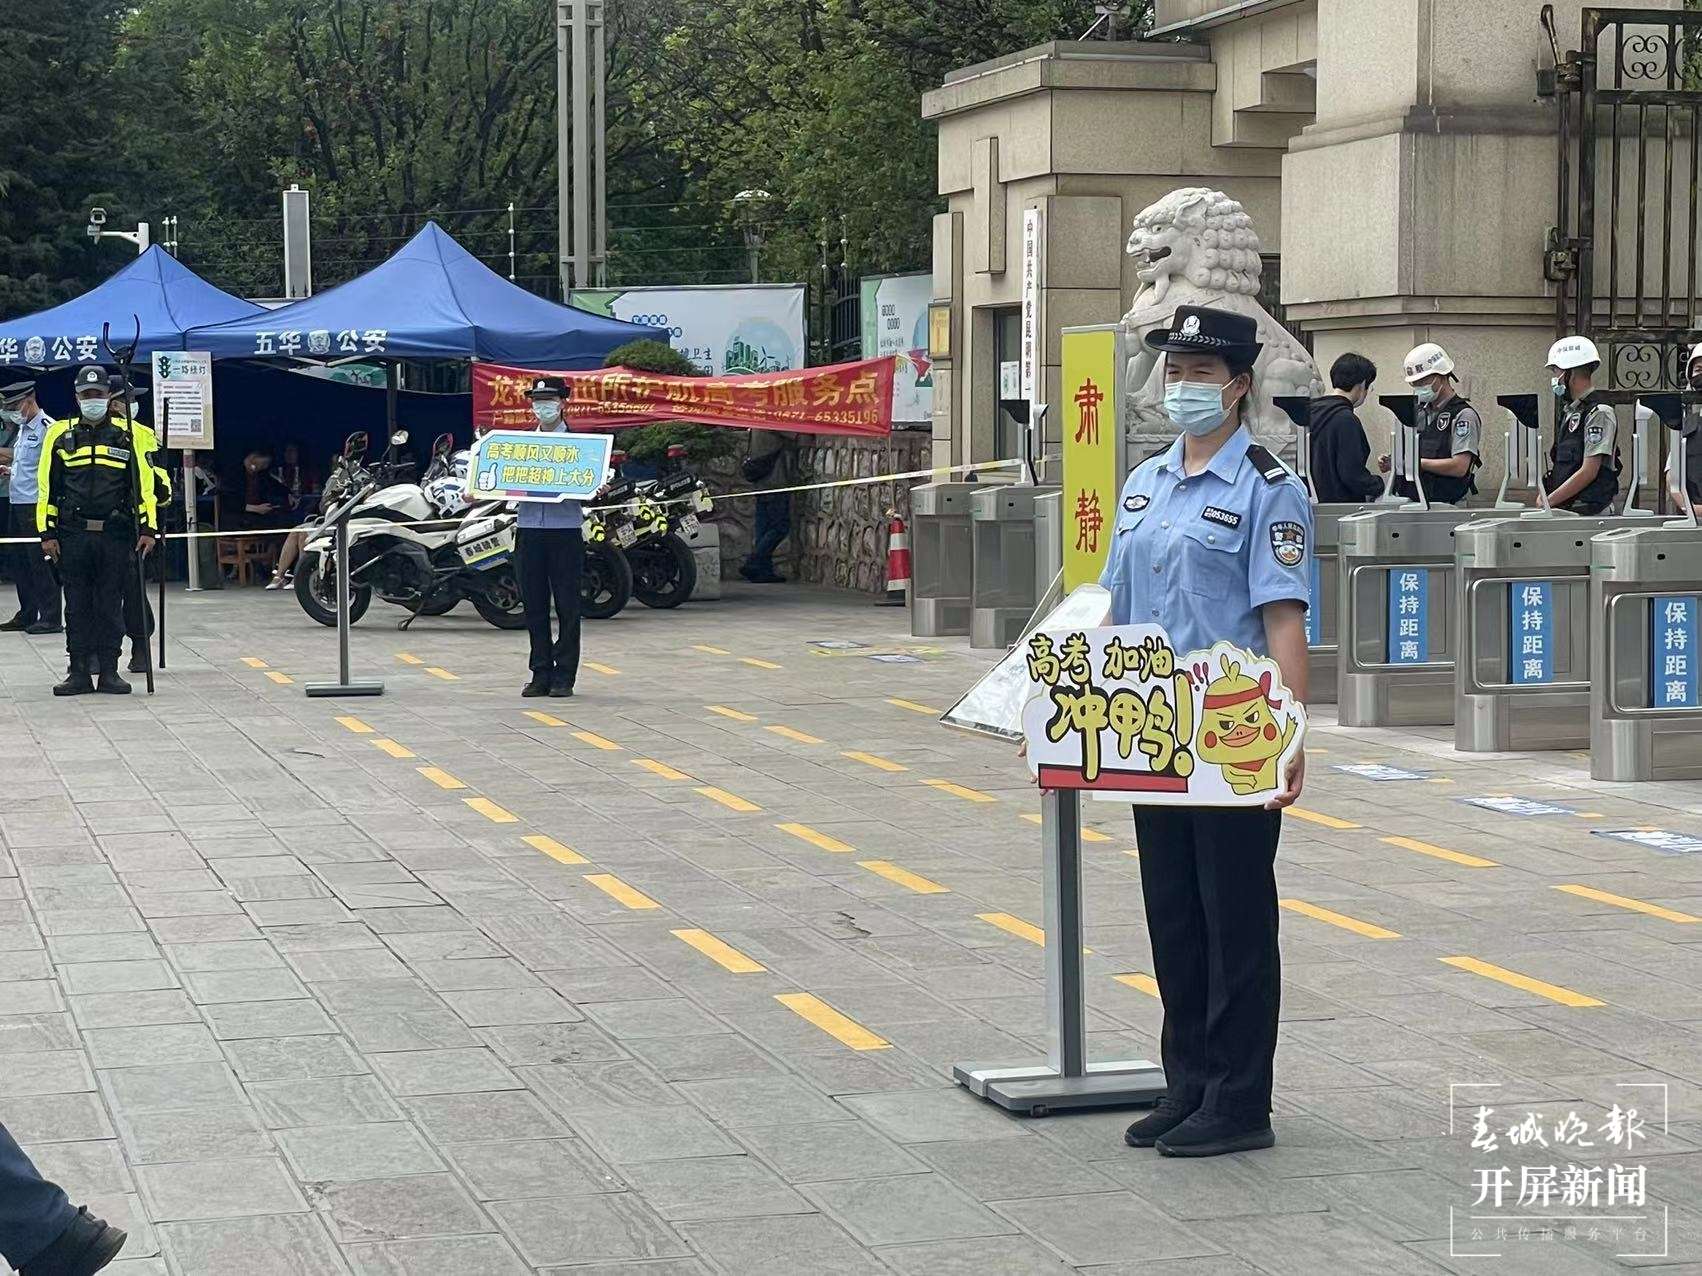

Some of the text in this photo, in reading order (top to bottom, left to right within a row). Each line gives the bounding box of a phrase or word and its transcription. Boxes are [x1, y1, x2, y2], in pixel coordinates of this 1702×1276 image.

[51, 335, 98, 361] 公安
[254, 329, 388, 355] 五华 公安
[486, 442, 581, 463] 高考顺风又顺水
[501, 465, 595, 487] 把把超神上大分
[1074, 377, 1104, 553] 肃静
[1399, 572, 1419, 660] 保持距离
[1522, 586, 1544, 679] 保持距离
[1664, 601, 1688, 703] 保持距离
